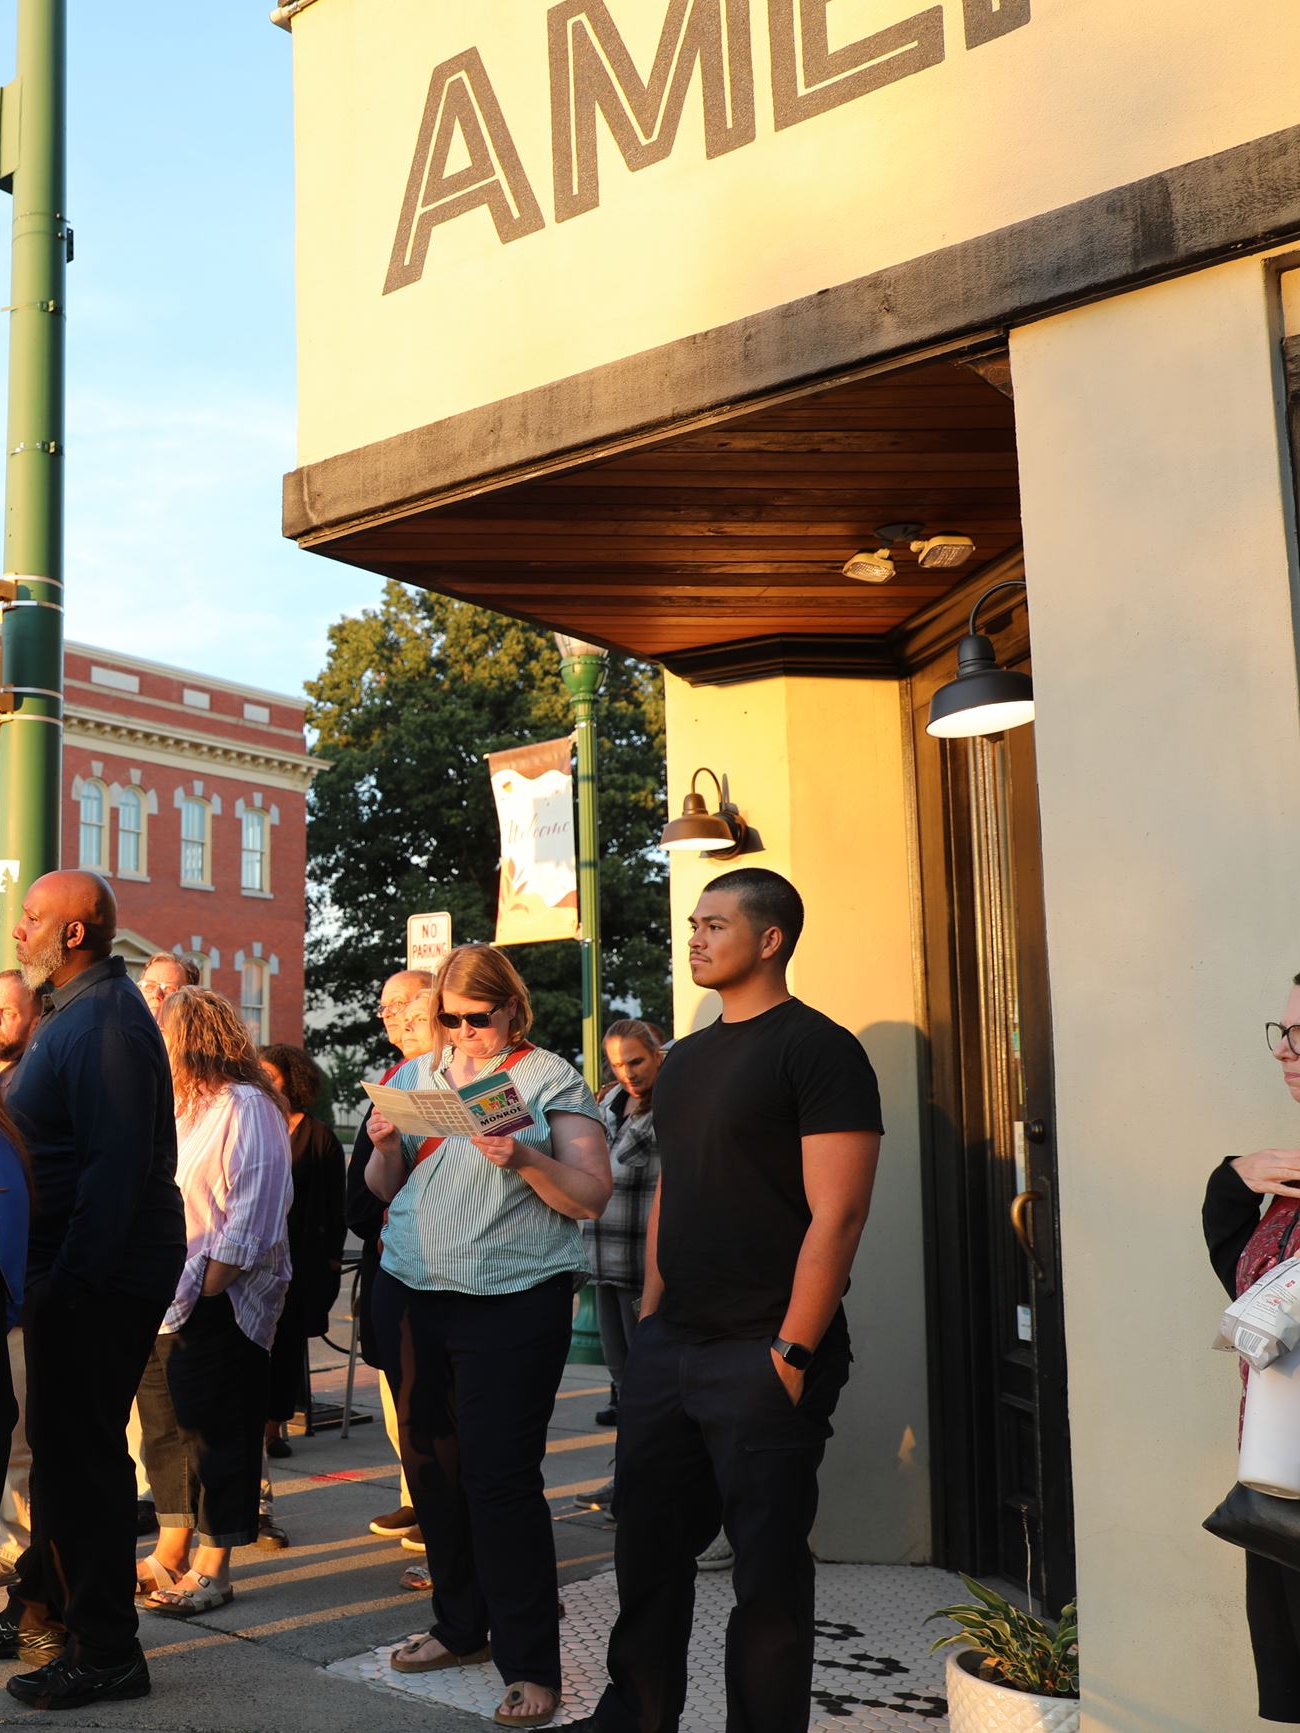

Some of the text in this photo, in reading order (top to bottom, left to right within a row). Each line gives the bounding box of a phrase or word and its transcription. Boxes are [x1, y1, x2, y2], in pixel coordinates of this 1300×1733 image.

[382, 0, 1032, 296] AME
[421, 923, 438, 938] NO
[412, 941, 448, 959] PARKING
[480, 1105, 524, 1127] MONROE
